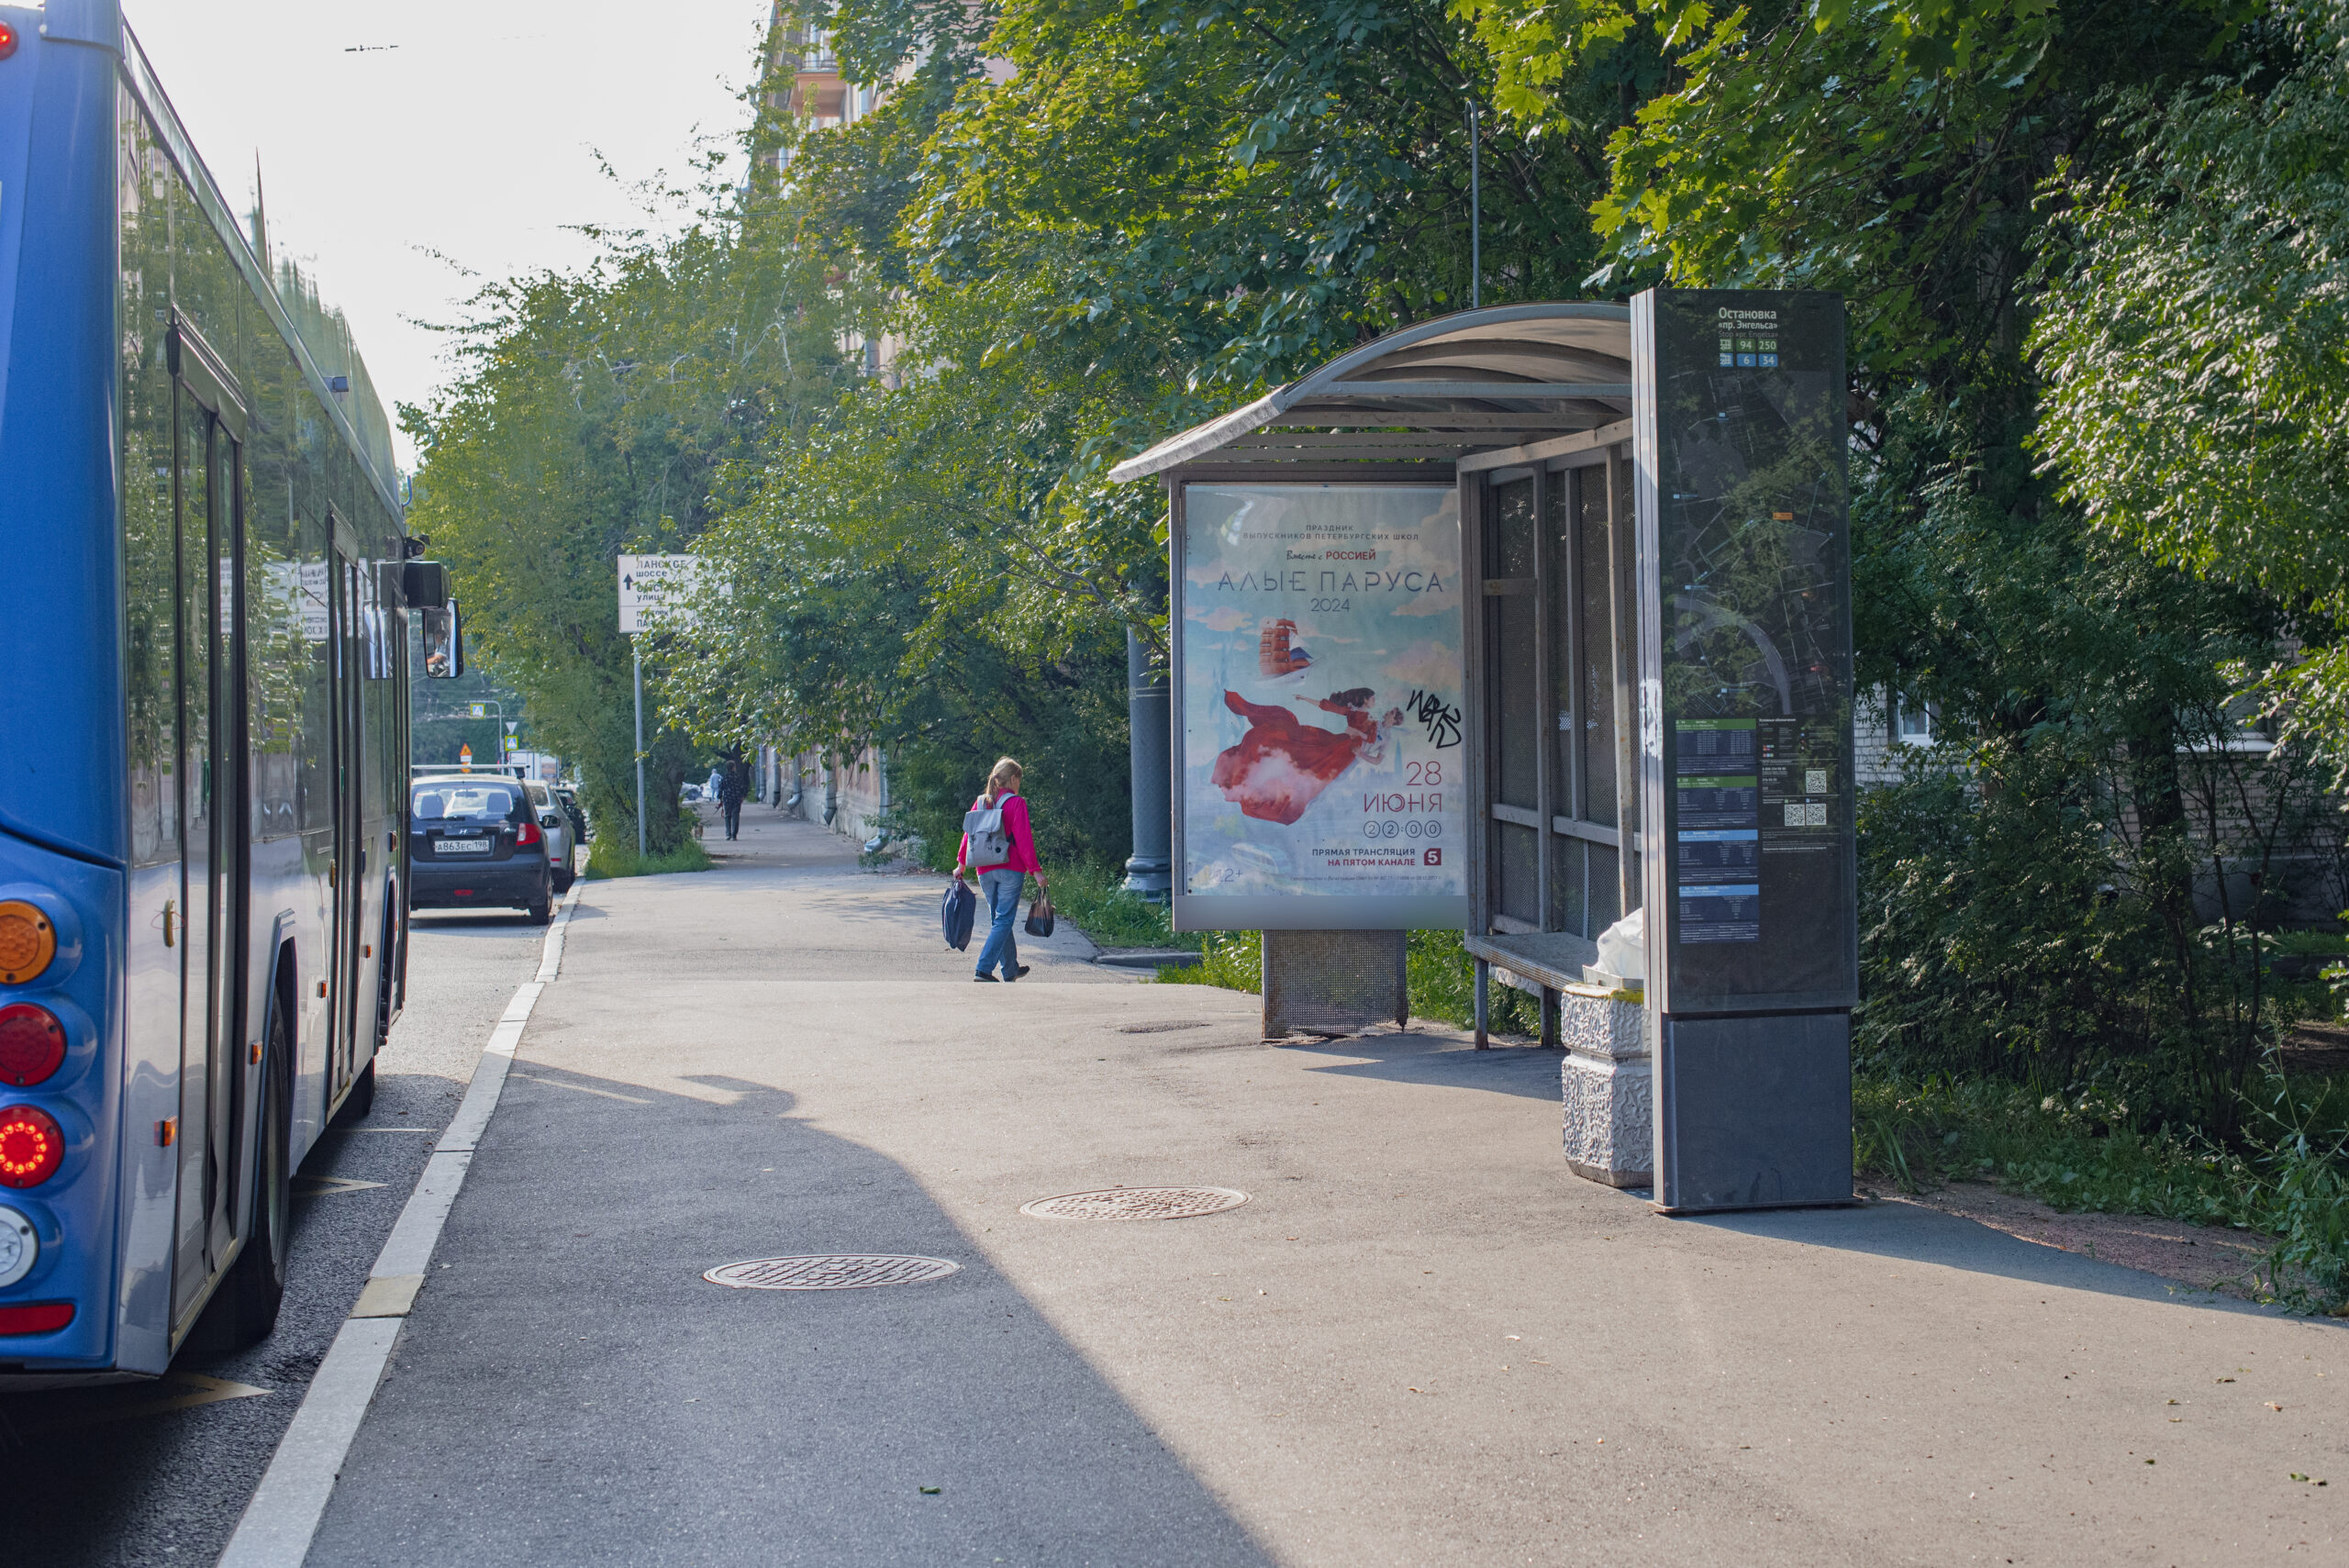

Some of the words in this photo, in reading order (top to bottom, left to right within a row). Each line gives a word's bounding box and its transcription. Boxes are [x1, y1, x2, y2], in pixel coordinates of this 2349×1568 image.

[1719, 307, 1776, 319] Остановка
[1718, 320, 1735, 330] «пр.
[1736, 320, 1777, 329] Энгельса»
[1718, 330, 1733, 339] Stop
[1740, 340, 1752, 350] 94
[1759, 340, 1776, 350] 250
[1743, 356, 1750, 364] 6
[1763, 356, 1775, 364] 34
[1242, 532, 1312, 540] ВЫПУСКНИКОВ
[1326, 549, 1376, 561] РОССИЕЙ
[1218, 571, 1307, 593] АЛЫЕ
[1320, 571, 1444, 593] ПАРУСА
[1310, 597, 1351, 612] 2024
[1406, 761, 1442, 786] 28
[1364, 793, 1442, 813] ИЮНЯ
[1312, 848, 1351, 856] ПРЯМАЯ
[1353, 848, 1416, 857] ТРАНСЛЯЦИЯ
[1328, 858, 1341, 866] НА
[1342, 858, 1376, 866] ПЯТОМ
[1378, 858, 1416, 866] КАНАЛЕ
